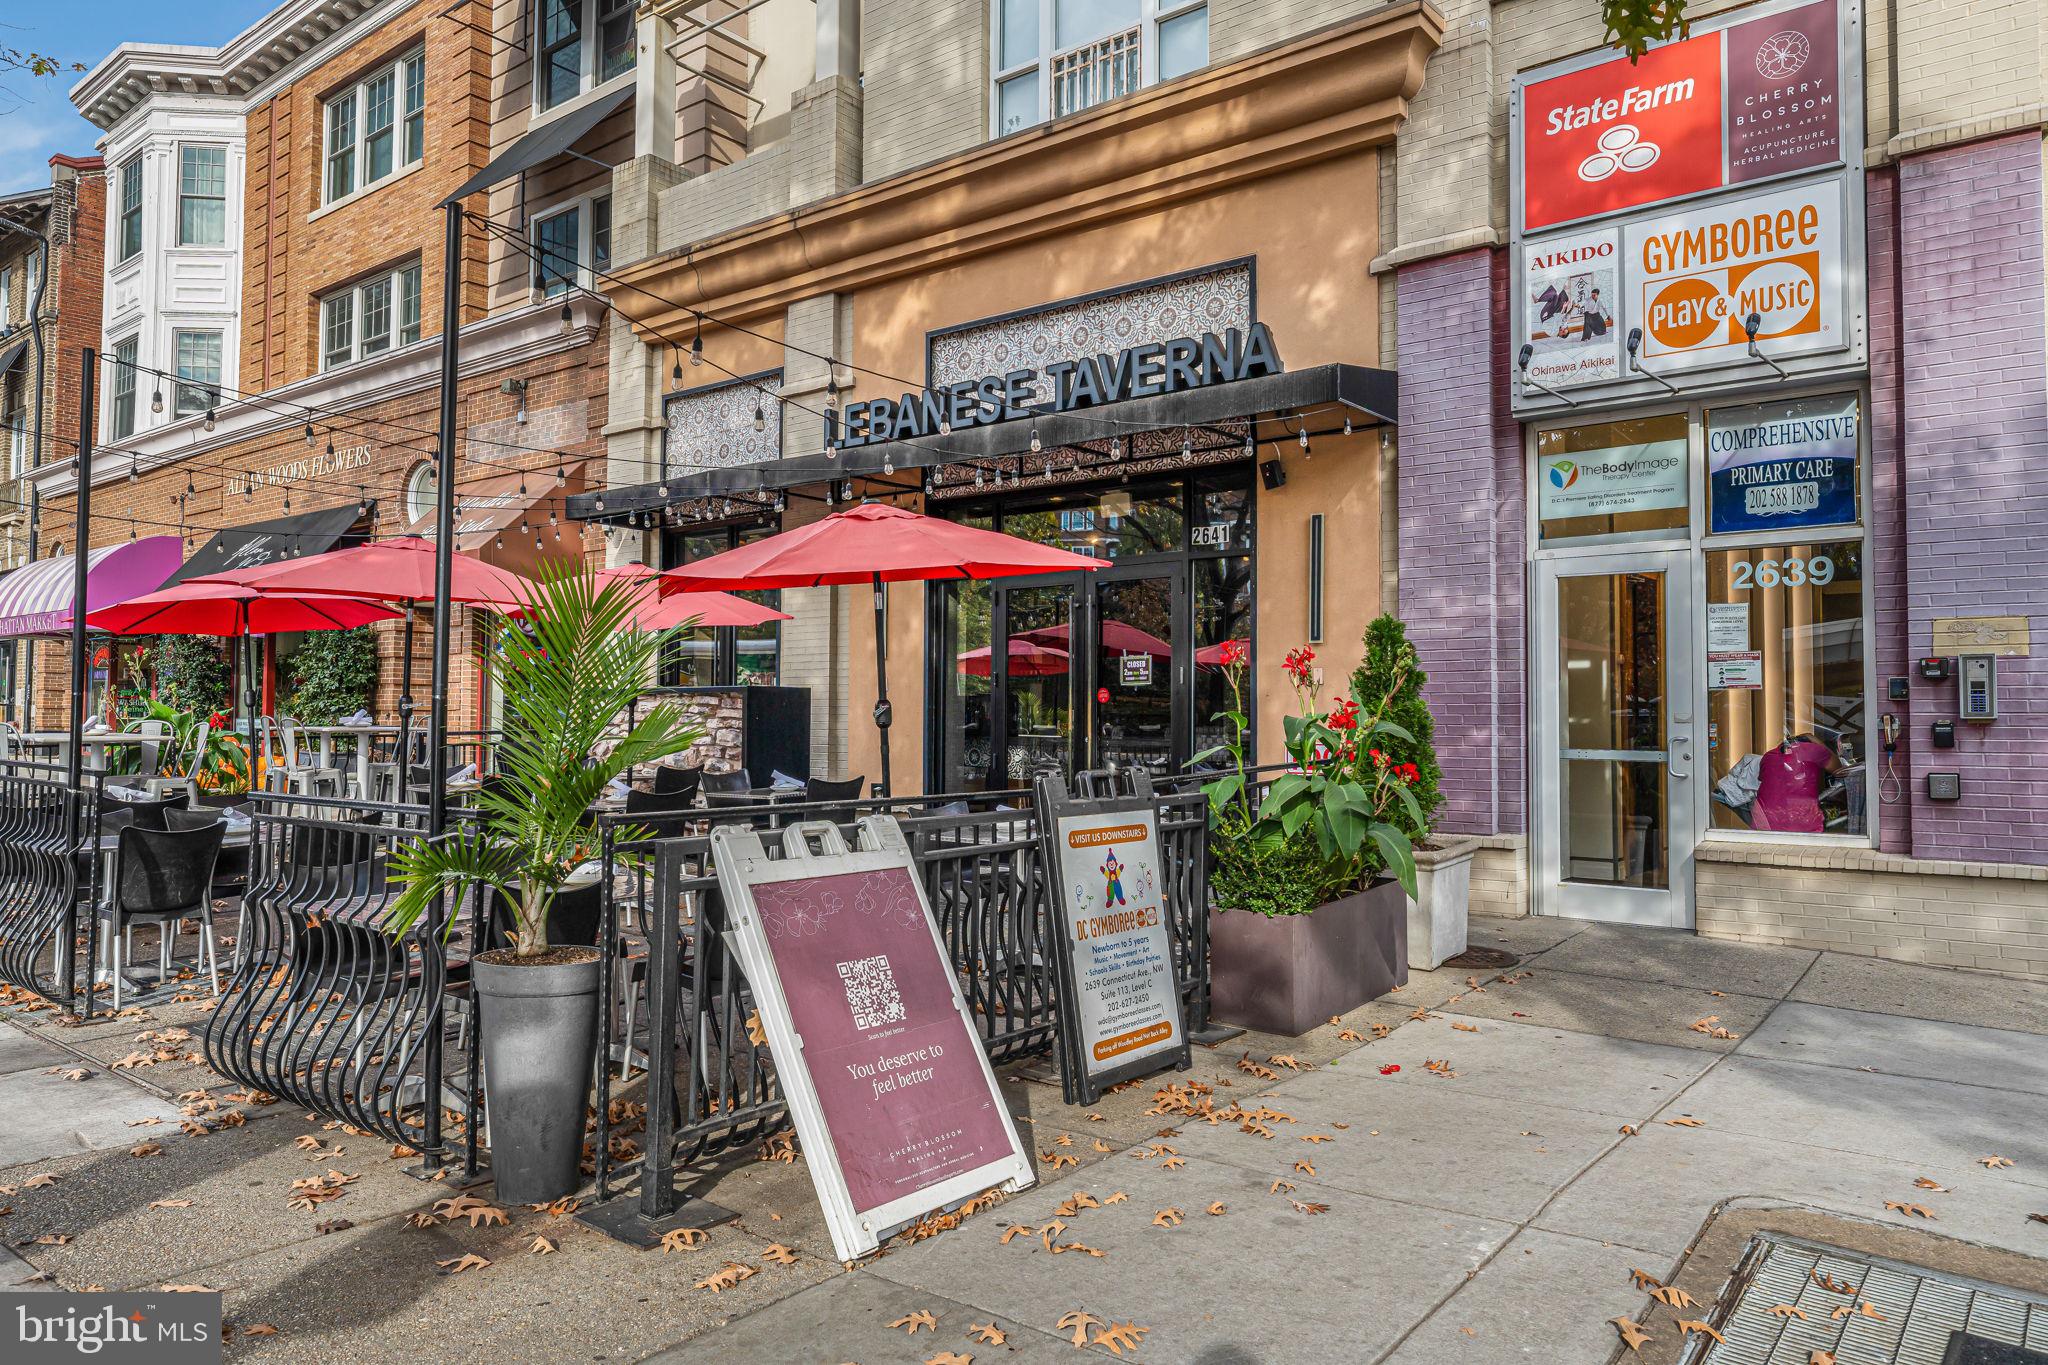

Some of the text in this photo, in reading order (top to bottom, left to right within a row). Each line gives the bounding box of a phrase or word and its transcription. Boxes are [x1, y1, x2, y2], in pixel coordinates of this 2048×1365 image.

[1745, 79, 1822, 106] CHERRY
[1736, 94, 1832, 126] BLOSSOM
[1742, 114, 1827, 139] HEALING ARTS
[1733, 137, 1836, 167] HERBAL MEDICINE
[1744, 129, 1825, 154] ACUPUNCTURE
[1531, 242, 1614, 271] AIKIDO
[1714, 298, 1727, 317] &
[1532, 356, 1615, 376] Okinawa Aikikai
[823, 322, 1282, 450] LEBANESE TAVERNA
[1711, 416, 1855, 453] COMPREHENSIVE
[228, 444, 372, 495] ALLAN WOODS FLOWERS
[1602, 470, 1657, 481] Therapy Center
[1730, 459, 1834, 486] PRIMARY CARE
[1750, 485, 1815, 509] 202 588 1878
[1192, 526, 1229, 544] 2641
[1731, 556, 1834, 589] 2639
[1075, 828, 1141, 844] VISIT US DOWNSTAIRS
[1076, 920, 1089, 941] DC
[1092, 936, 1150, 954] Newborn to 5 years
[1094, 956, 1108, 965] Music
[1113, 949, 1138, 959] Movement
[1126, 957, 1145, 968] Birthday
[1085, 979, 1101, 991] 2639
[1102, 970, 1136, 987] Connecticut
[1153, 963, 1164, 973] NW
[1100, 979, 1152, 1000] Suite 113, Level C
[847, 1044, 943, 1079] You deserve to
[872, 1067, 933, 1101] feel better
[890, 1128, 962, 1159] CHERRY BLOSSOM
[908, 1144, 953, 1164] HEALING ARTS
